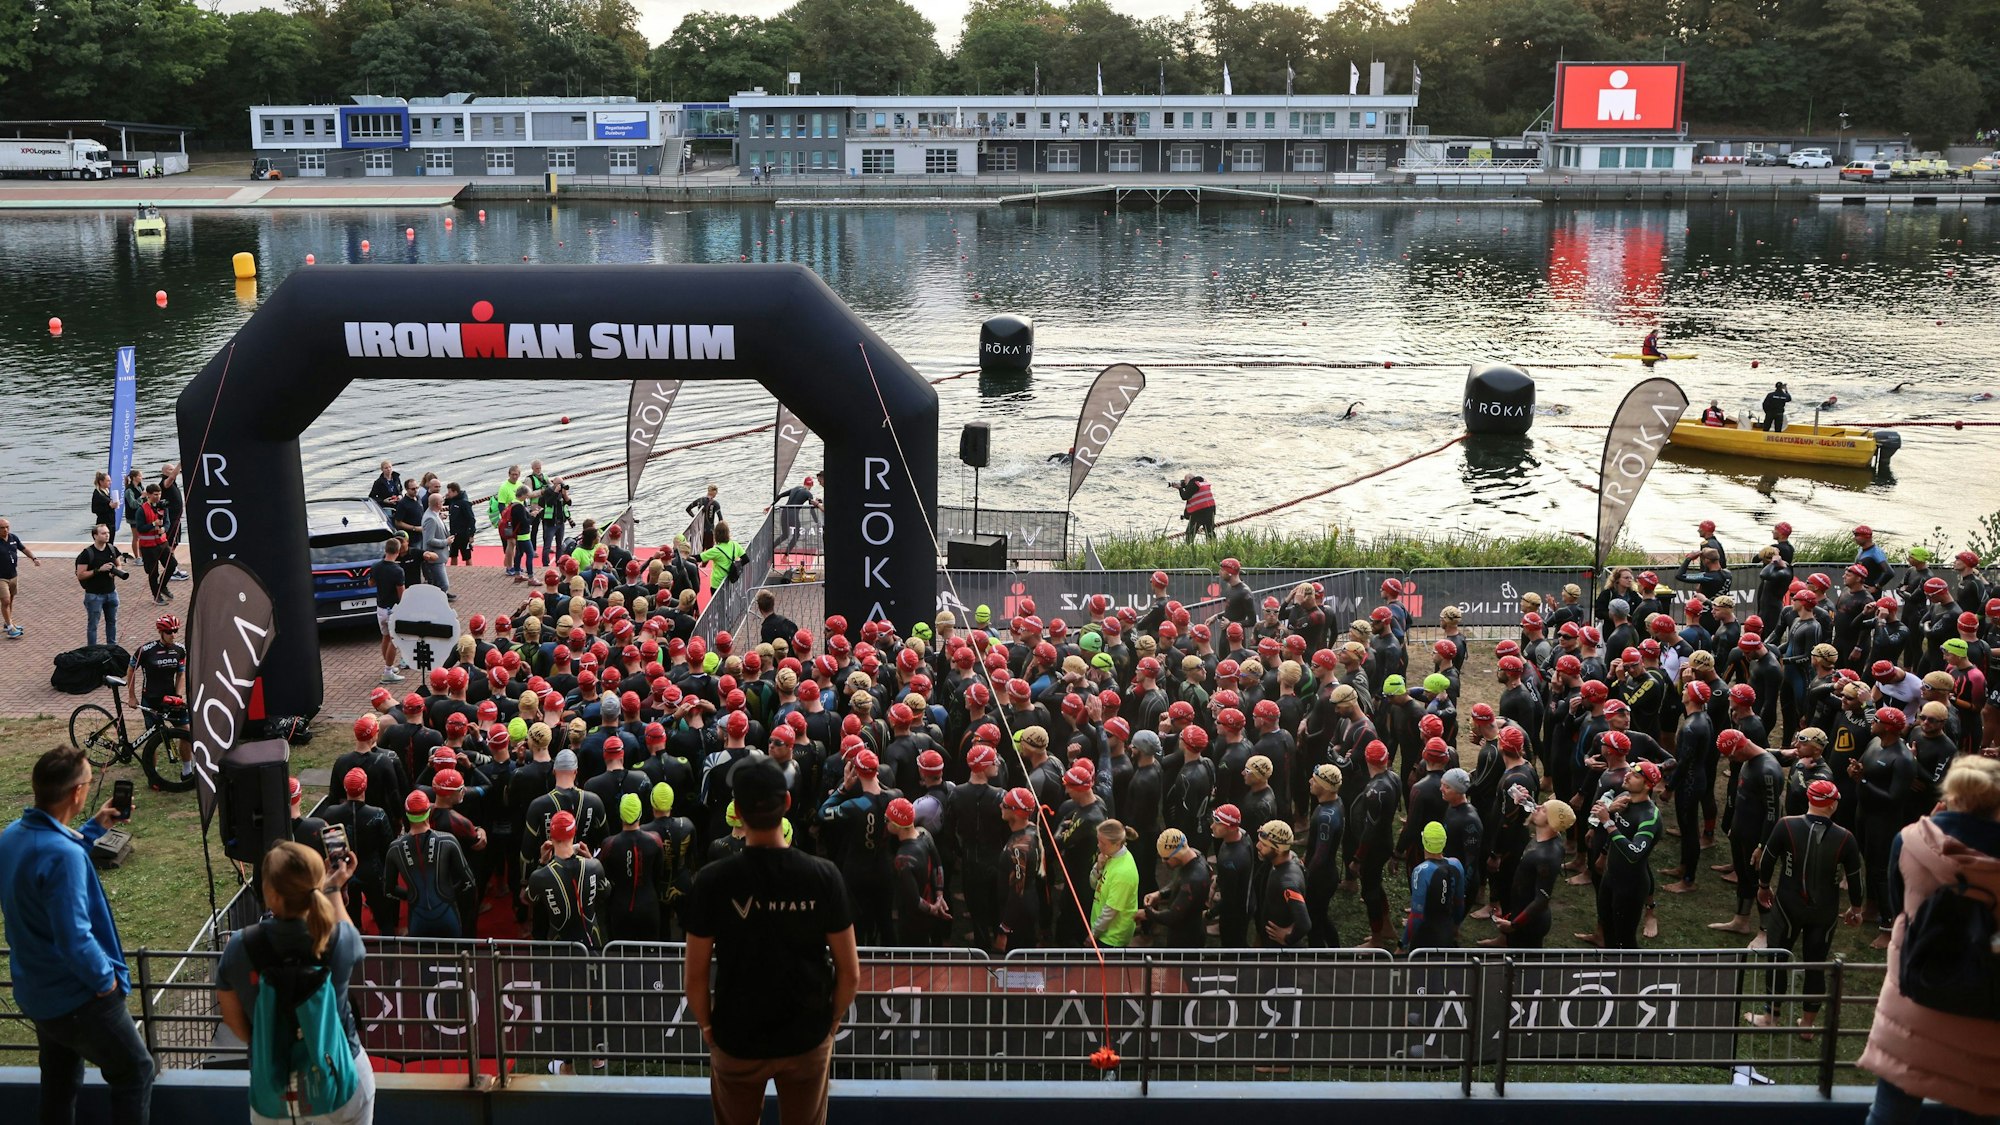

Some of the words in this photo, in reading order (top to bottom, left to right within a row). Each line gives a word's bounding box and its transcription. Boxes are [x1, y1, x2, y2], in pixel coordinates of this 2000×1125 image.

[344, 320, 577, 359] IRONMAN
[588, 322, 736, 360] SWIM
[122, 409, 130, 453] Together
[132, 725, 157, 749] LOOK
